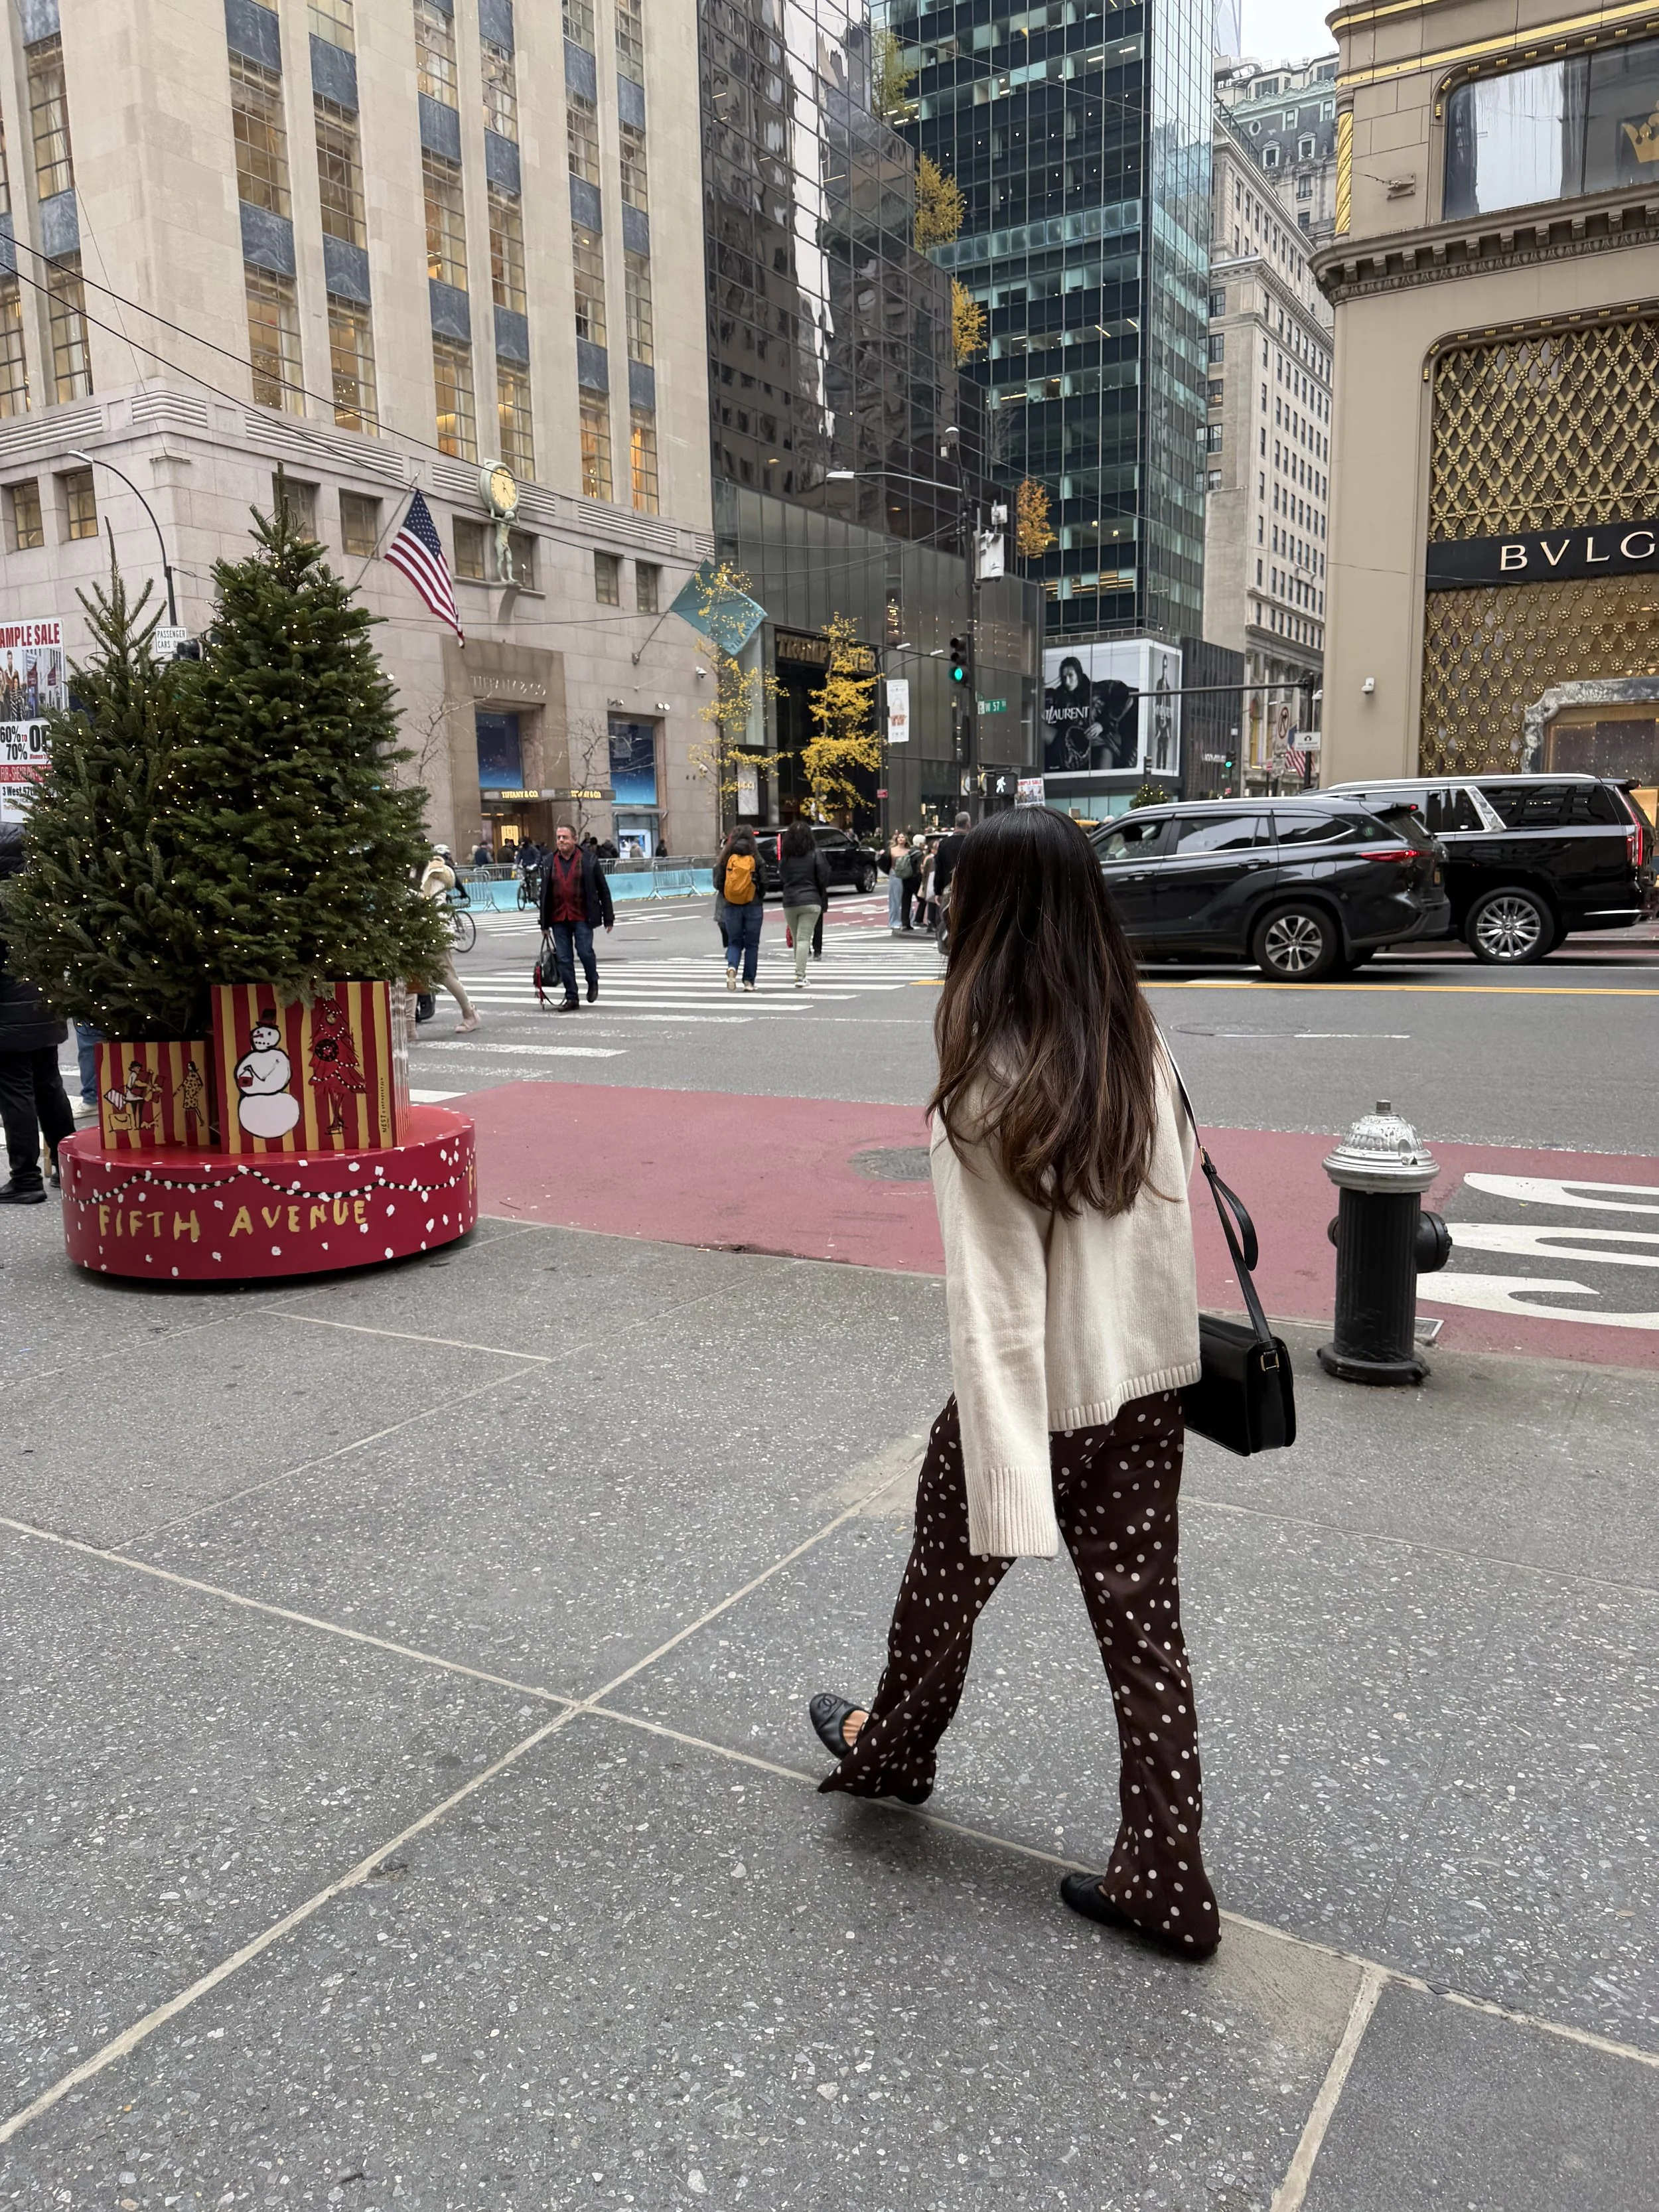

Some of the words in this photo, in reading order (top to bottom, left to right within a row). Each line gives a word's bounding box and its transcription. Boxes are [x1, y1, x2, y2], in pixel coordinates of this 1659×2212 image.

[1500, 531, 1656, 571] BVLG
[35, 623, 60, 646] SALE
[776, 633, 828, 664] TRUMP
[993, 701, 1000, 711] 57
[6, 743, 27, 761] 70%
[2, 786, 6, 796] 3
[7, 786, 21, 796] West
[99, 1205, 200, 1240] FIFTH
[229, 1199, 366, 1237] AVENUE
